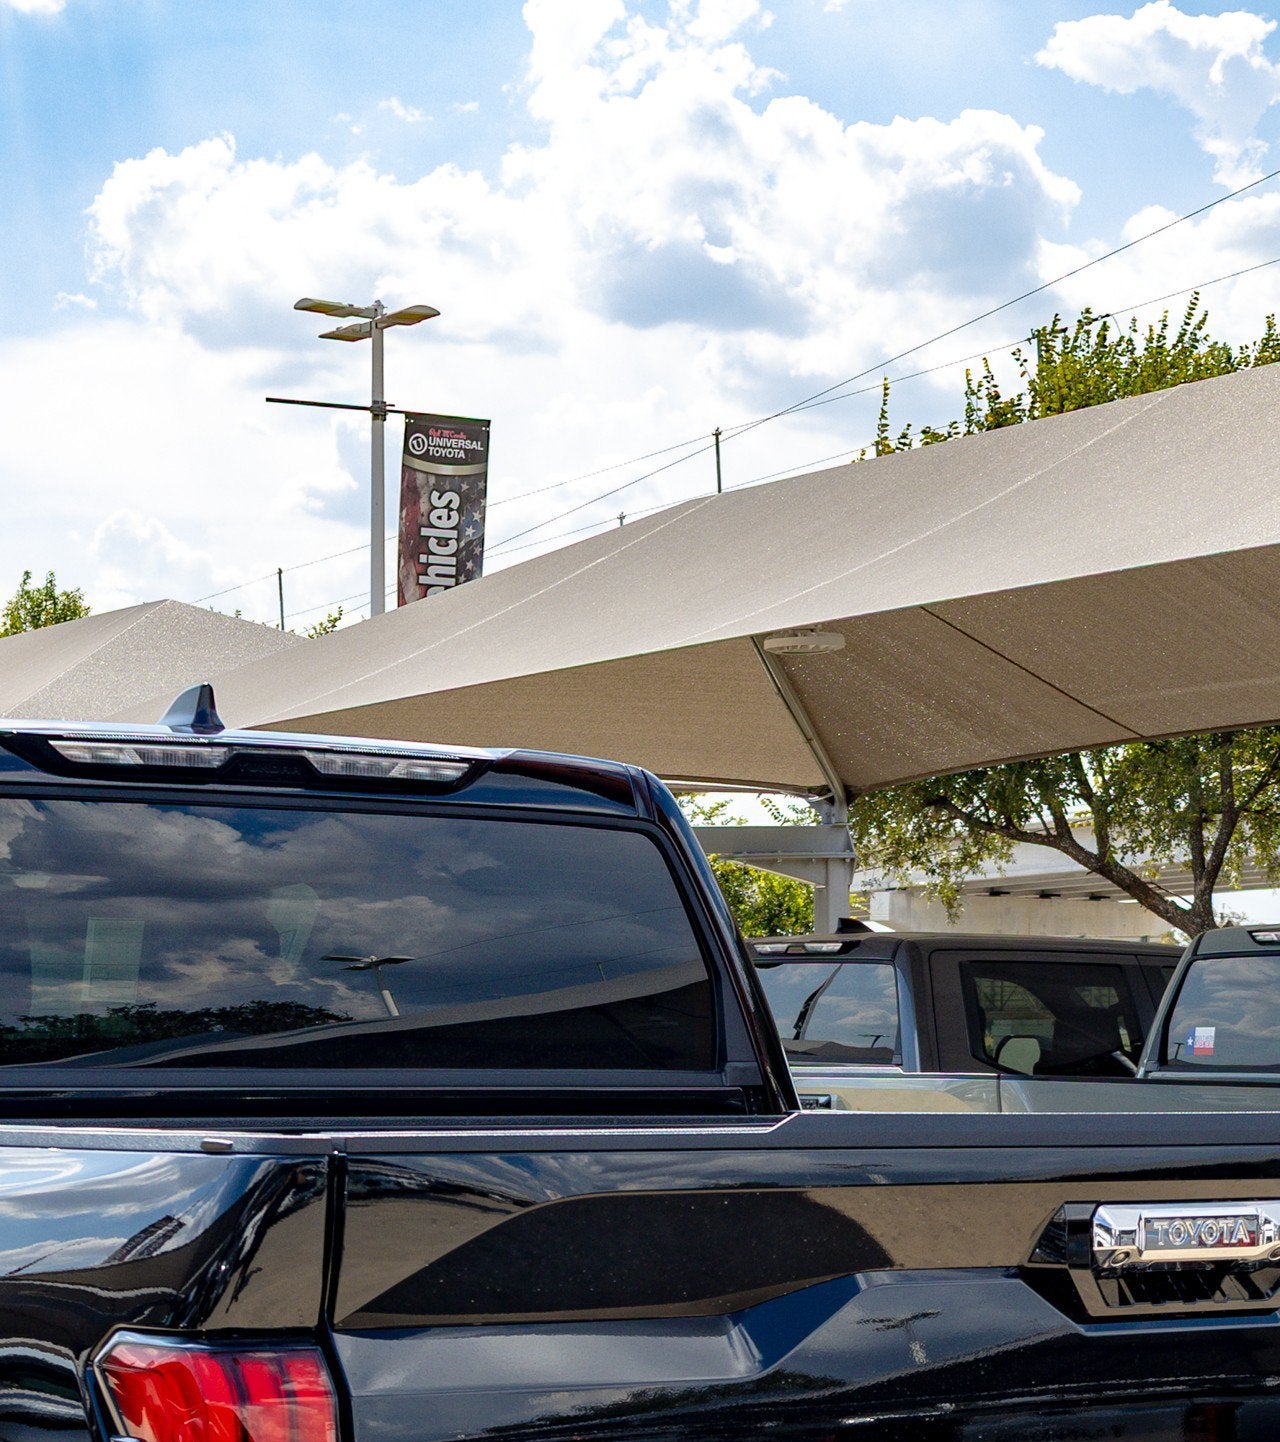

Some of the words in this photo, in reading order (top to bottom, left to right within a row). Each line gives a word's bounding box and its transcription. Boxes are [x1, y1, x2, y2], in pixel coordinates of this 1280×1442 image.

[428, 437, 484, 451] UNIVERSAL
[428, 446, 466, 459] TOYOTA
[1152, 1217, 1251, 1246] TOYOTA
